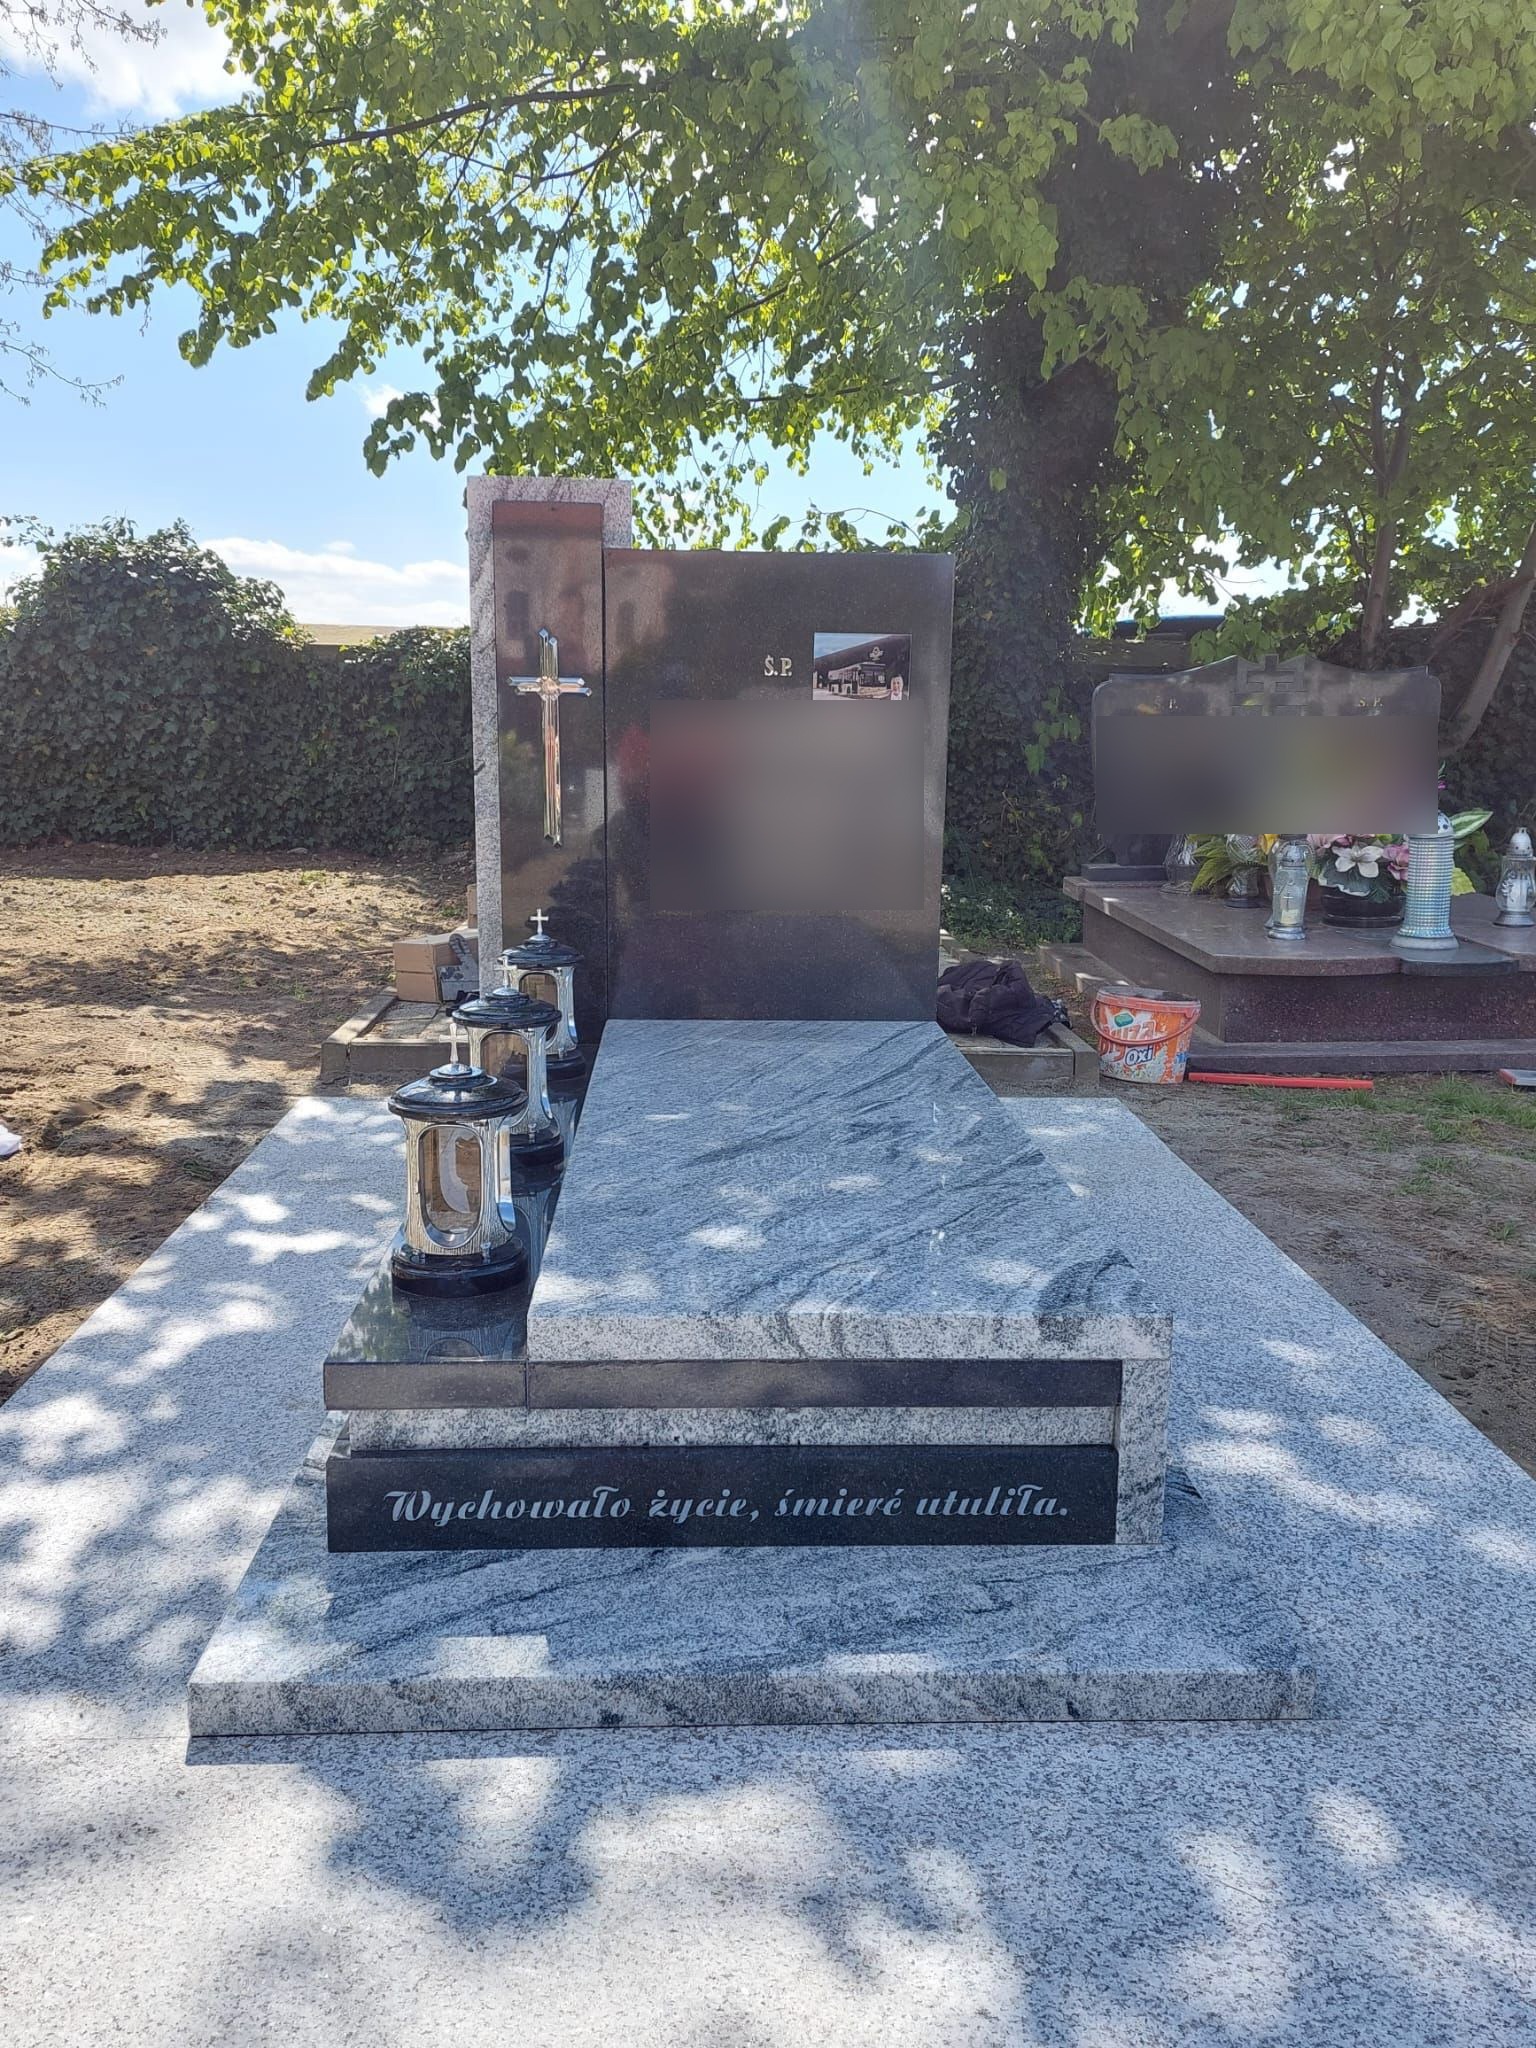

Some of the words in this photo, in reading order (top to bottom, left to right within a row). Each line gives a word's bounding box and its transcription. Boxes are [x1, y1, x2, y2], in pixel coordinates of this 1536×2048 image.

[384, 1486, 632, 1527] Wychowało
[648, 1489, 760, 1524] życie,
[774, 1489, 903, 1517] śmierć
[915, 1484, 1068, 1516] utuliła.
